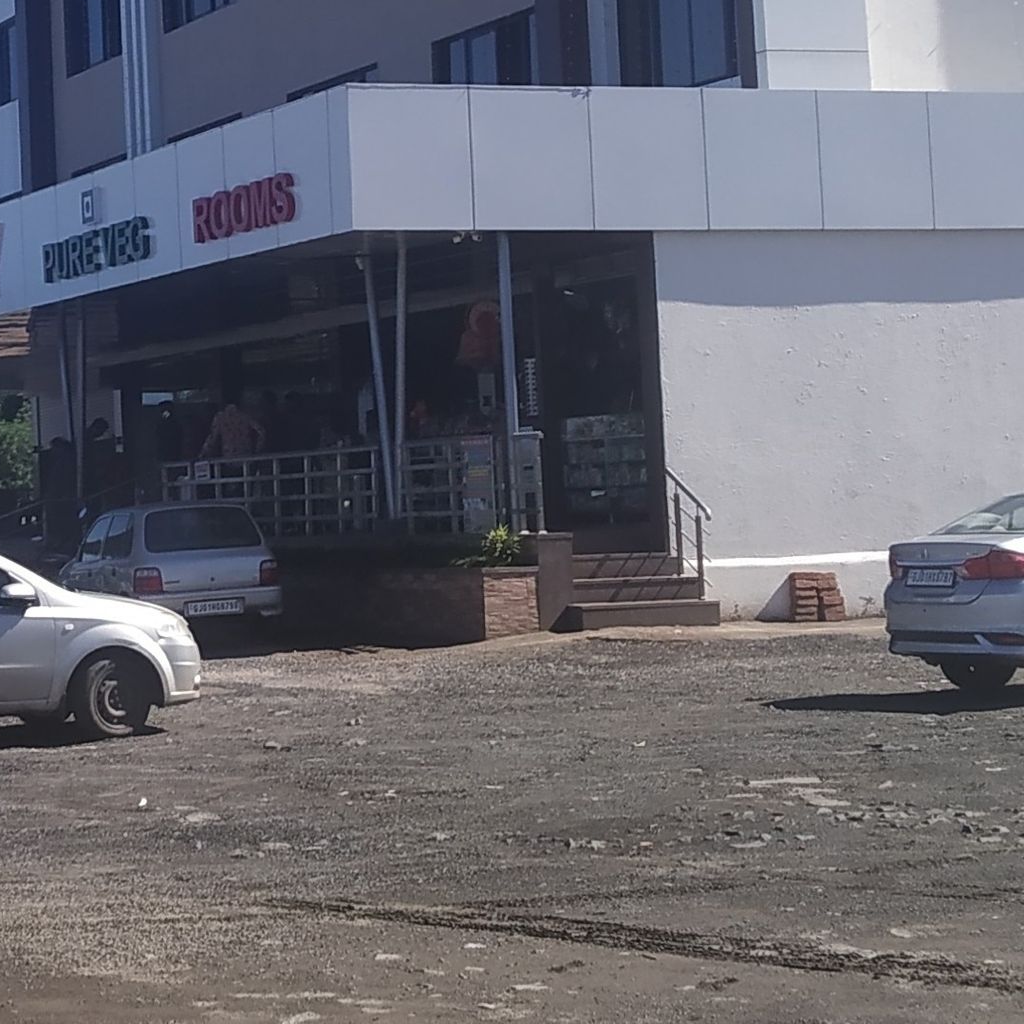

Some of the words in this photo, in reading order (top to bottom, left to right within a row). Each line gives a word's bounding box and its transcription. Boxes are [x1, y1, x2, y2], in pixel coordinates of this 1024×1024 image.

[192, 173, 296, 244] ROOMS
[42, 230, 101, 284] PURE
[98, 216, 150, 268] VEG
